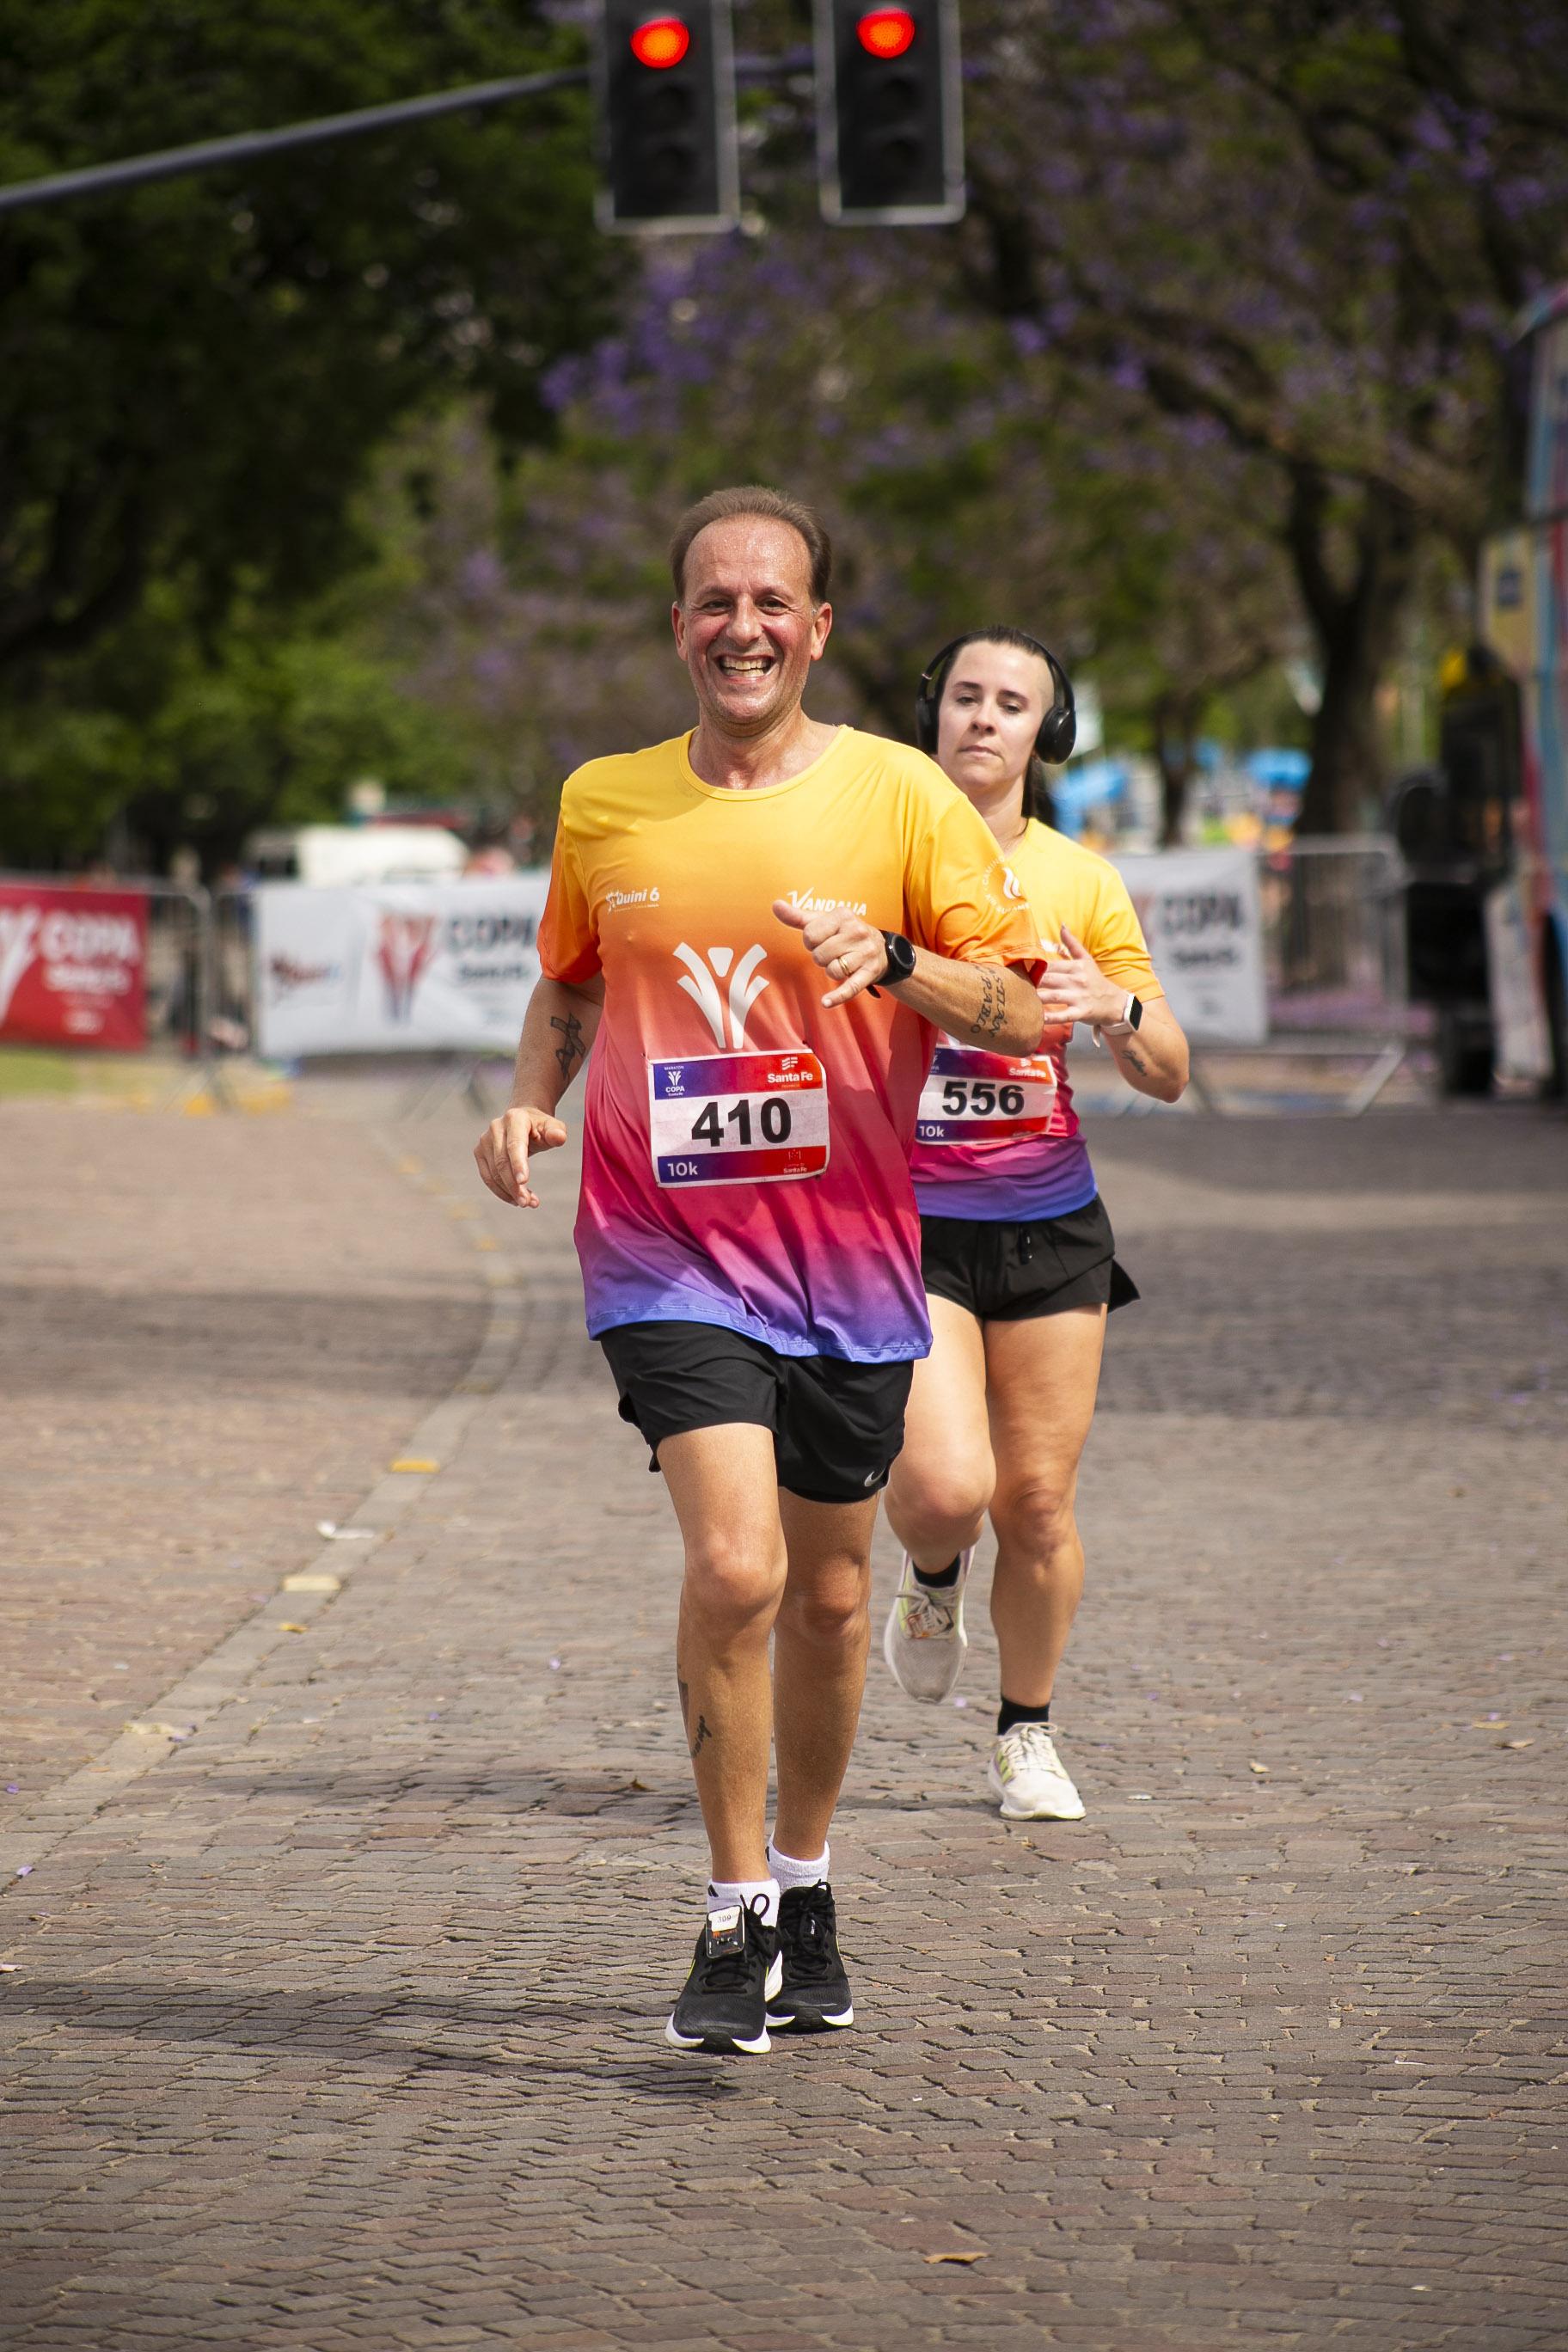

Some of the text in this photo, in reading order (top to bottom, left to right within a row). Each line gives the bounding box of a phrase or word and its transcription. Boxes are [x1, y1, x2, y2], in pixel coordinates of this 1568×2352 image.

[650, 887, 660, 902] 6
[971, 976, 992, 1034] PABLO
[768, 1071, 813, 1083] Santa Fe
[1009, 1068, 1035, 1077] Santa
[941, 1081, 1025, 1117] 556
[691, 1097, 792, 1148] 410
[919, 1125, 945, 1137] 10k
[667, 1161, 698, 1177] 10k
